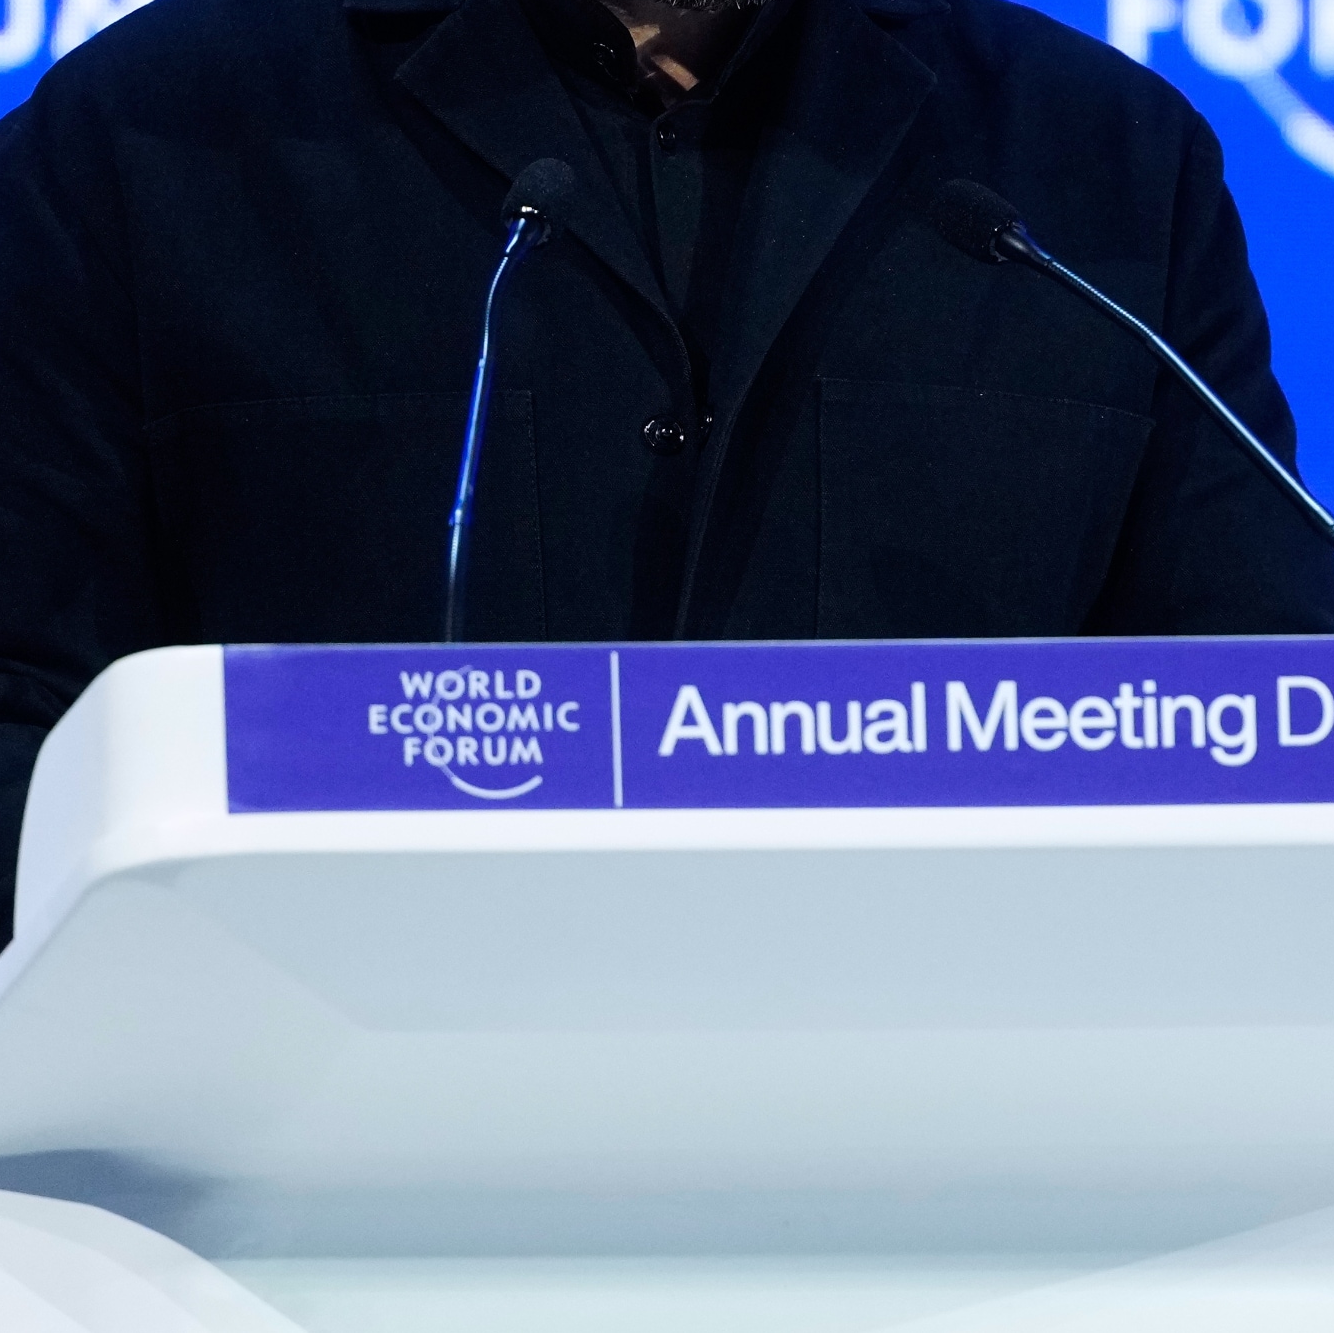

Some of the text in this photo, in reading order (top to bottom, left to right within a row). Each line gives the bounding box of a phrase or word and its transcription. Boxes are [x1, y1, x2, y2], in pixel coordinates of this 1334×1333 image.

[399, 669, 542, 701] WORLD
[367, 701, 581, 735] ECONOMIC
[658, 681, 927, 756] Annual
[945, 680, 1258, 767] Meeting
[402, 735, 544, 767] FORUM
